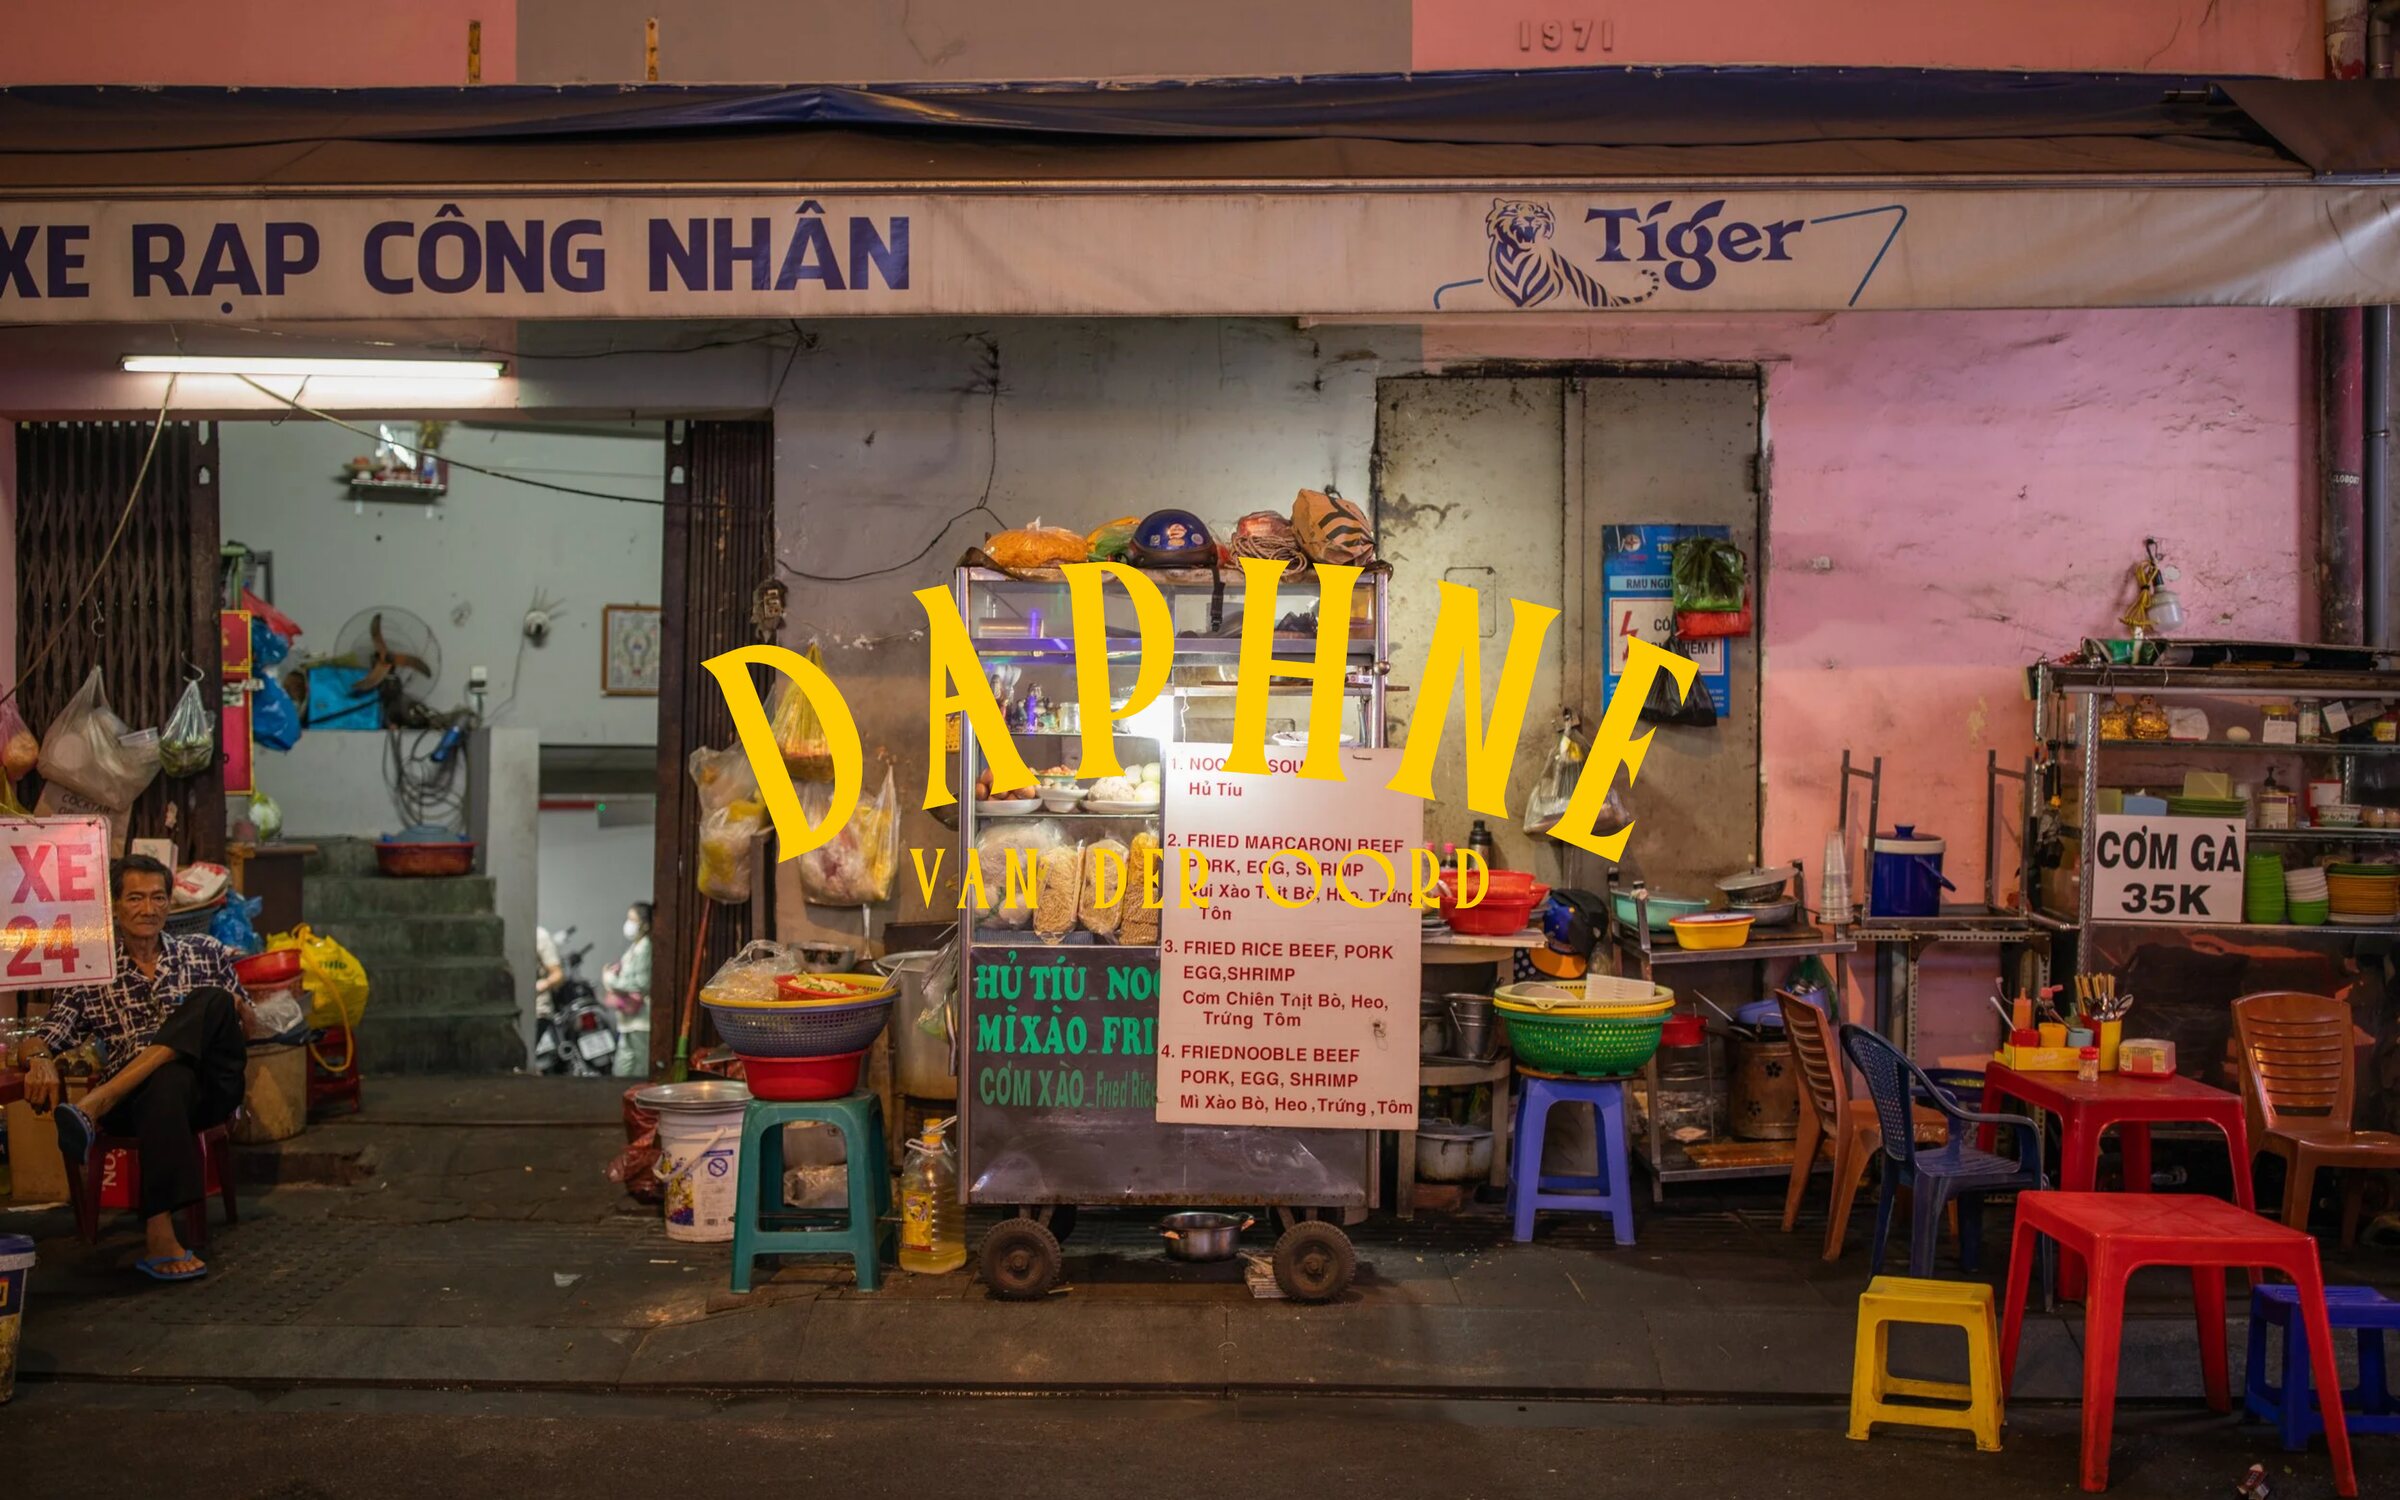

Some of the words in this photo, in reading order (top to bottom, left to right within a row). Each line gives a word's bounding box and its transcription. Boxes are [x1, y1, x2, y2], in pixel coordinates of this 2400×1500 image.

[1519, 19, 1613, 52] 1971
[0, 225, 89, 298] XE
[133, 223, 320, 314] RẠP
[364, 204, 606, 294] CÔNG
[649, 201, 910, 292] NHÂN
[1626, 578, 1648, 589] RMU
[1188, 780, 1212, 796] Hủ
[1216, 782, 1243, 797] Tíu
[1167, 833, 1181, 848] 2.
[1187, 834, 1240, 849] FRIED
[1245, 836, 1352, 852] MARCARONI
[2096, 824, 2179, 870] CƠM
[2190, 824, 2242, 872] GÀ
[10, 843, 96, 905] XE
[1219, 883, 1251, 899] Xào
[2121, 882, 2211, 916] 35K
[5, 913, 80, 977] 24
[1164, 939, 1178, 953] 3.
[1184, 940, 1236, 956] FRIED
[1241, 942, 1283, 957] RICE
[1289, 943, 1339, 961] BEEF,
[1344, 945, 1394, 960] PORK
[975, 950, 1025, 1000] HỦ
[1028, 955, 1087, 1001] TÍU
[1106, 965, 1161, 1001] NO
[1182, 990, 1220, 1005] Cơm
[1226, 991, 1275, 1007] Chiên
[1318, 993, 1346, 1011] Bò,
[1351, 995, 1389, 1012] Heo,
[1203, 1011, 1254, 1030] Trứng
[1263, 1012, 1302, 1027] Tôm
[1102, 1016, 1159, 1056] FRI
[1160, 1044, 1176, 1059] 4.
[1313, 1048, 1361, 1063] BEEF
[1037, 1060, 1084, 1108] XÀO
[1180, 1070, 1235, 1087] PORK,
[1241, 1071, 1285, 1089] EGG,
[1289, 1072, 1359, 1088] SHRIMP
[1179, 1094, 1199, 1109] Mì
[1204, 1094, 1237, 1110] Xào
[1241, 1095, 1269, 1113] Bò,
